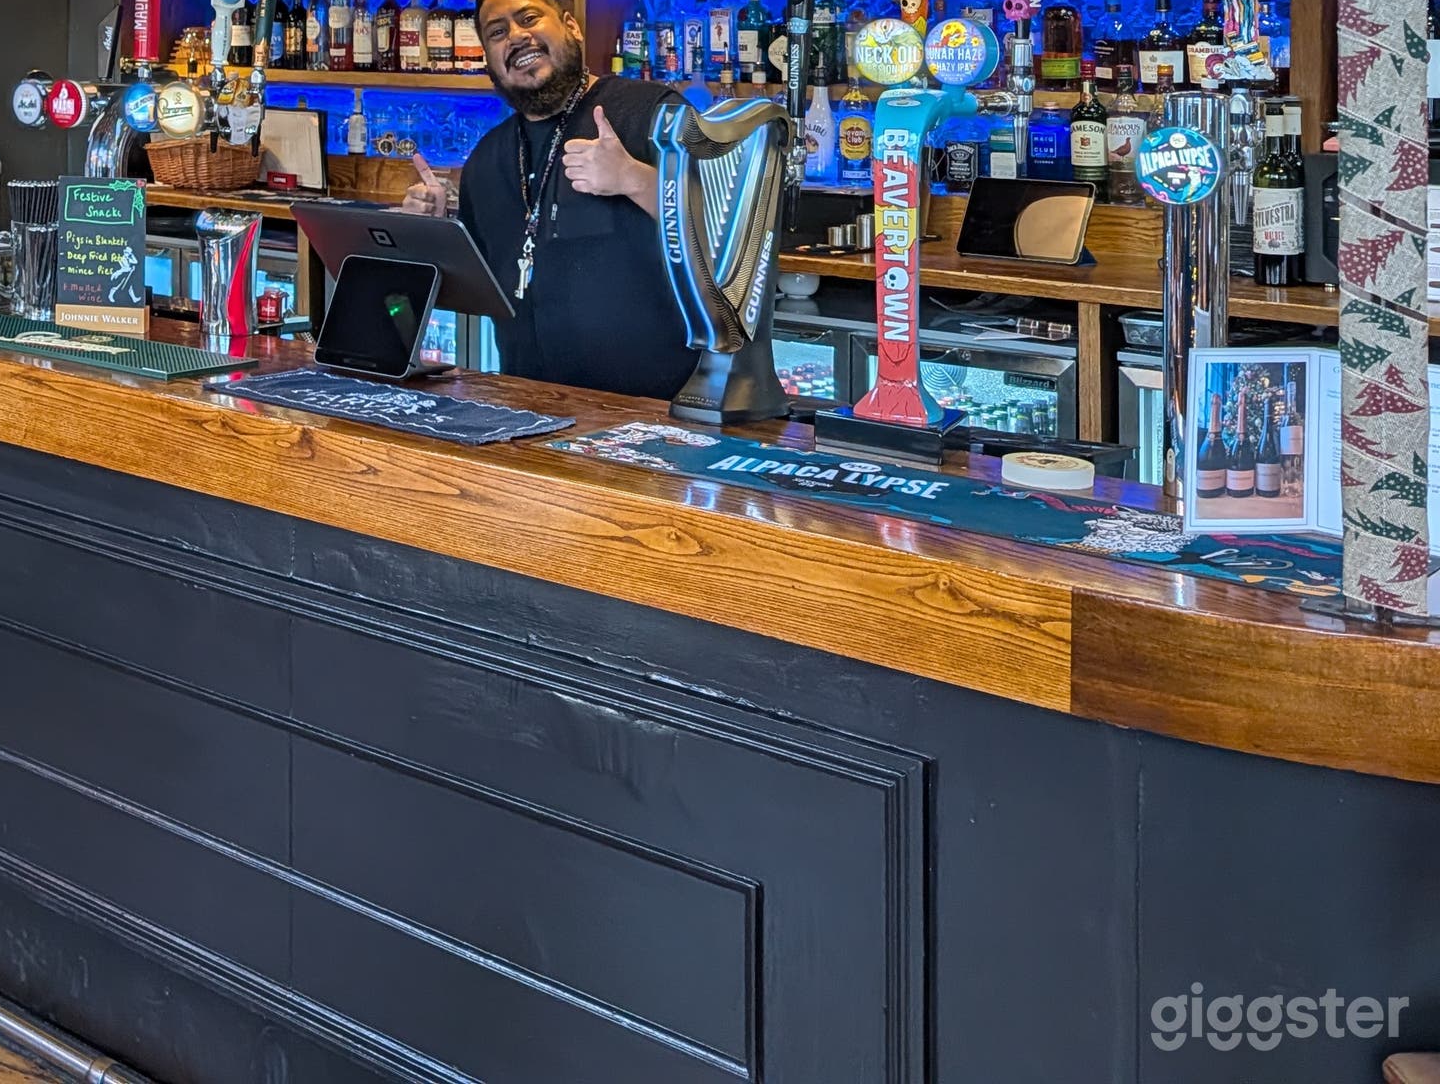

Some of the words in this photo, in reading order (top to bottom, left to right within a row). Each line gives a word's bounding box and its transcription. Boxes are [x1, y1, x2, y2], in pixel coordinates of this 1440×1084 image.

[855, 46, 893, 64] NECK
[898, 45, 920, 63] OIL
[958, 47, 984, 60] HAZE
[789, 43, 799, 90] GUINNESS
[937, 63, 955, 72] HAZY
[957, 63, 969, 71] IPA
[805, 124, 827, 137] LIBU
[73, 188, 114, 202] Festive
[663, 180, 683, 264] GUINNESS
[66, 231, 85, 250] Pigs
[95, 235, 128, 248] Blankets
[883, 129, 910, 342] BEAVERTOWN
[67, 252, 87, 263] Deep
[89, 251, 108, 261] Fried
[746, 229, 774, 324] GUINNESS
[60, 311, 99, 322] JOHNNIE
[101, 314, 138, 325] WALKER
[707, 455, 839, 480] ALPACA
[842, 471, 950, 499] LYPSE
